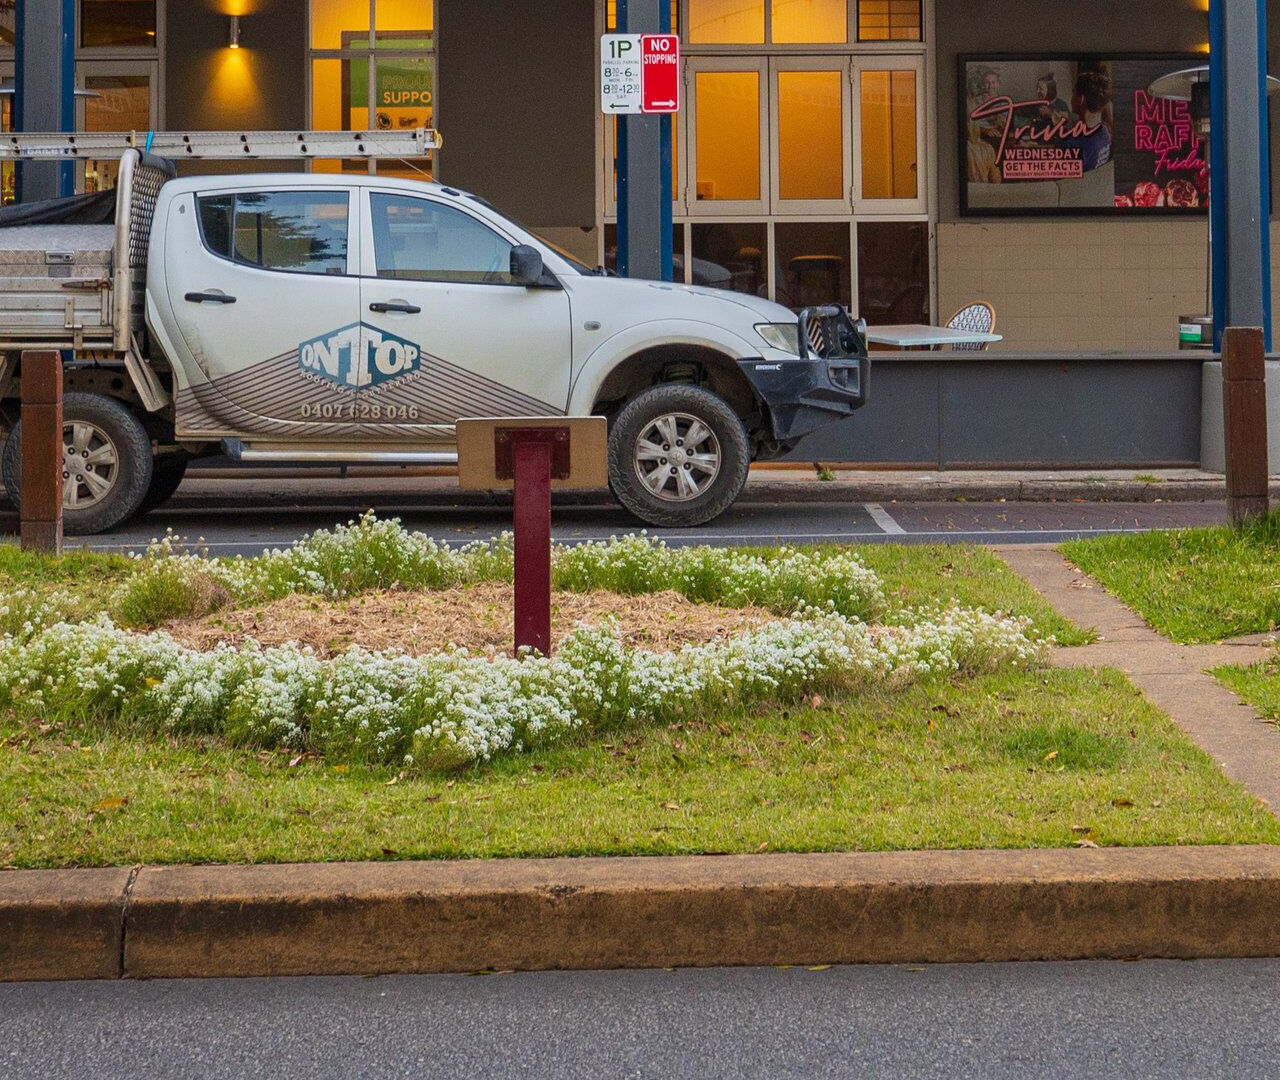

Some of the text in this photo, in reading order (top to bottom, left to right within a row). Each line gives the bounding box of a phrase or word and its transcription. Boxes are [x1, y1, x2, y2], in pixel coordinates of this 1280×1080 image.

[609, 40, 632, 58] 1P
[651, 39, 670, 51] NO
[644, 54, 676, 65] STOPPING
[383, 75, 432, 89] PROU
[383, 91, 432, 104] SUPPO
[1135, 90, 1191, 122] ME
[971, 95, 1105, 165] Trivia
[1005, 148, 1080, 160] WEDNESDAY
[1006, 162, 1080, 171] GET THE FACTS
[300, 370, 344, 393] ROOFING
[301, 403, 418, 419] 0407 628 046
